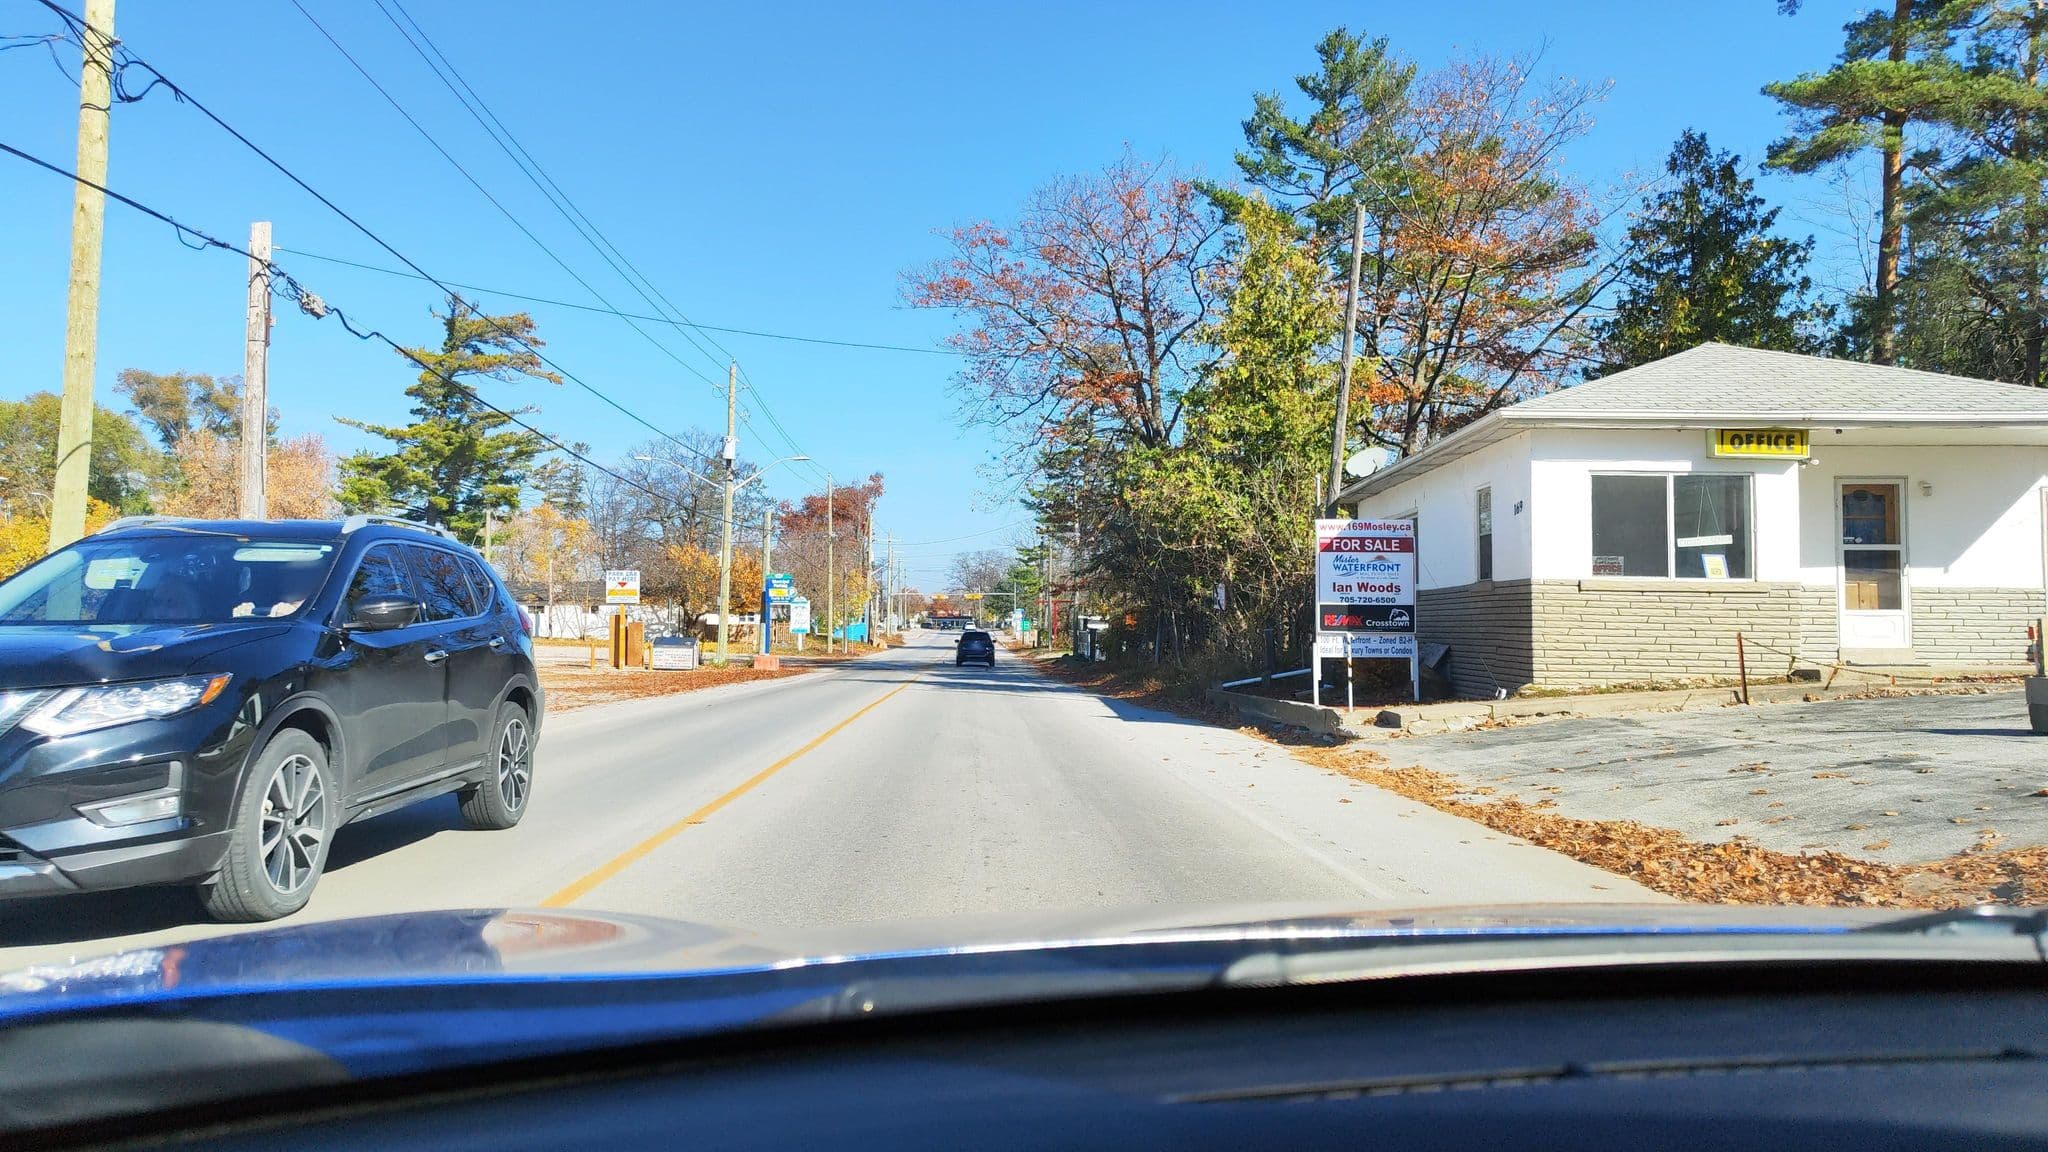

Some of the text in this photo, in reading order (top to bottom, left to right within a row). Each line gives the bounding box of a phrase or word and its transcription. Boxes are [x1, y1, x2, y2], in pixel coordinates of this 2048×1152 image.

[1730, 433, 1795, 450] OFFICE
[1514, 500, 1523, 516] 169
[1320, 522, 1411, 532] www.169Mosley.ca
[1333, 539, 1400, 551] FOR SALE
[1333, 554, 1359, 563] Mister
[1333, 563, 1401, 572] WATERFRONT
[1333, 582, 1401, 593] Ian Woods
[1366, 619, 1410, 627] Crosstown
[1379, 636, 1397, 644] Zoned
[1344, 646, 1363, 656] Lxury
[1365, 646, 1382, 654] Towns
[1391, 646, 1412, 655] Condos
